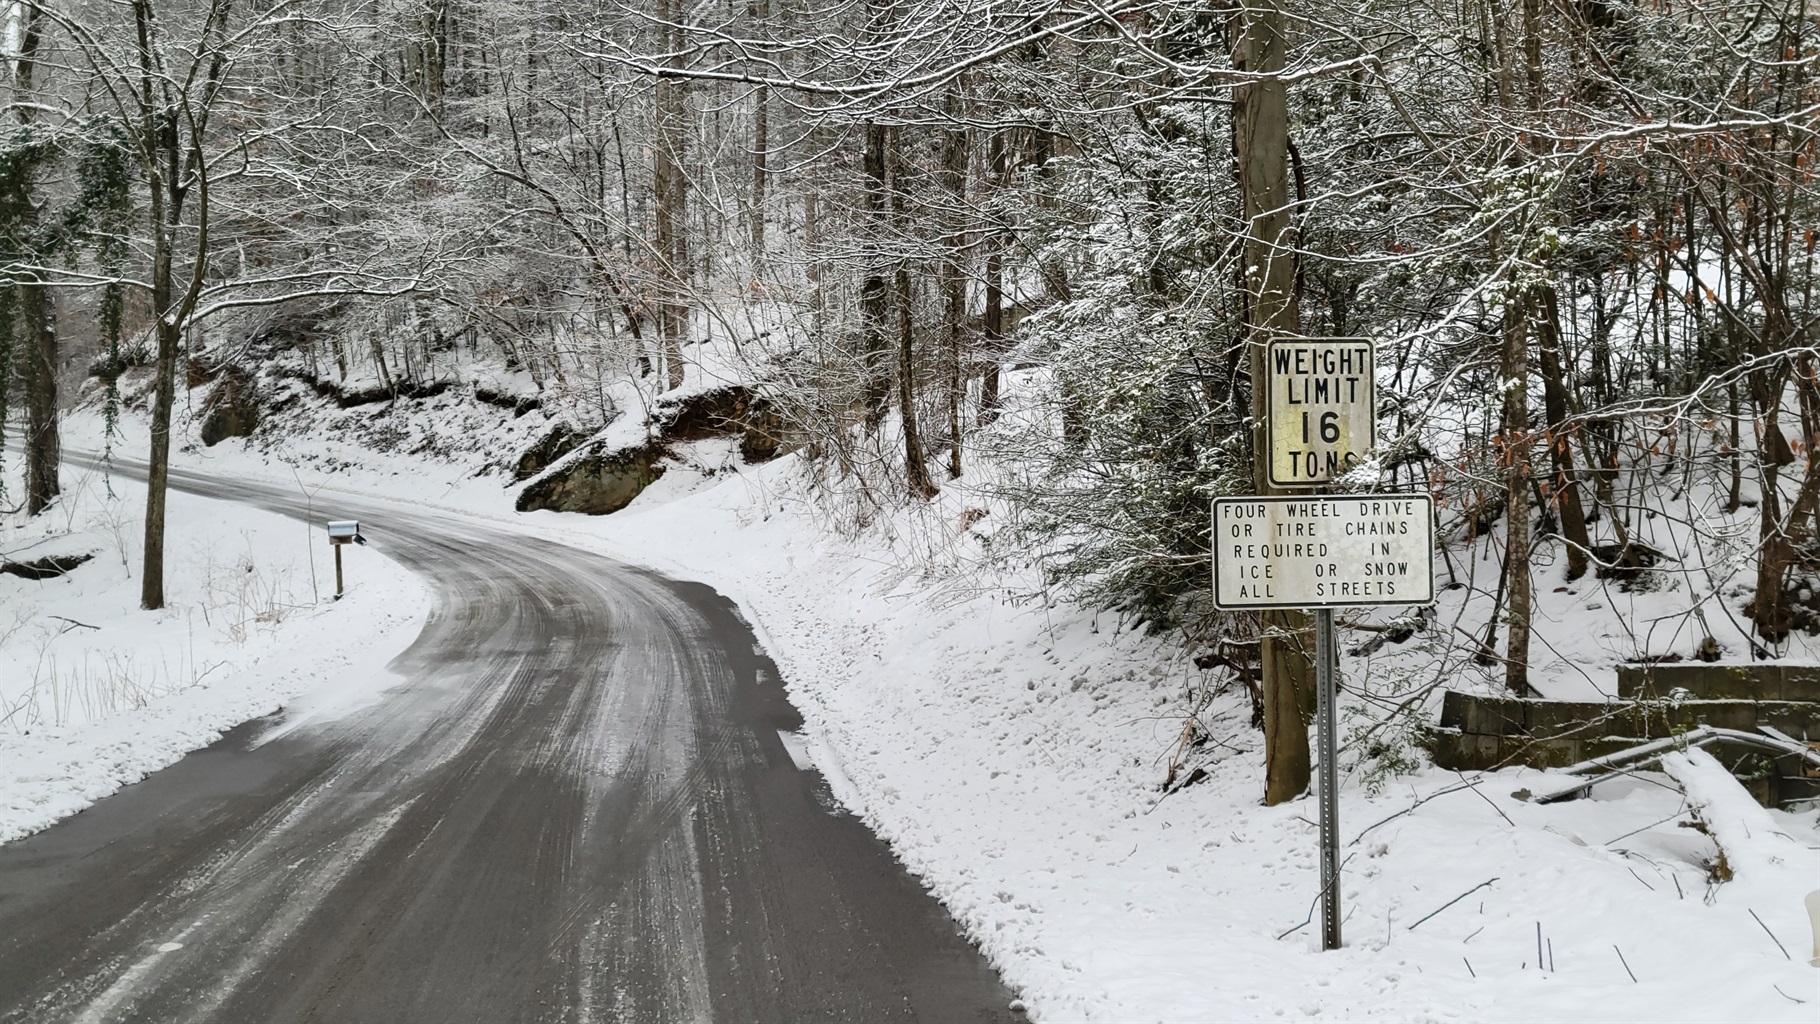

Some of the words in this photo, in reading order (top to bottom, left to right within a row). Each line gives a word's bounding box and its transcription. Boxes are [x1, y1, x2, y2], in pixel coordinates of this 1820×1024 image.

[1274, 348, 1368, 375] WEIGHT
[1288, 377, 1359, 405] LIMIT
[1302, 411, 1340, 444] 16
[1224, 504, 1266, 519] FOUR
[1287, 503, 1340, 517] WHEEL
[1360, 502, 1413, 517] DRIVE
[1231, 523, 1253, 538] OR
[1276, 522, 1316, 537] TIRE
[1345, 521, 1409, 536] CHAINS
[1234, 543, 1328, 559] REQUIRED
[1371, 542, 1390, 556] IN
[1240, 565, 1273, 579] ICE
[1315, 563, 1337, 577] OR
[1365, 562, 1408, 576] SNOW
[1239, 584, 1274, 598] ALL
[1316, 581, 1396, 597] STREETS
